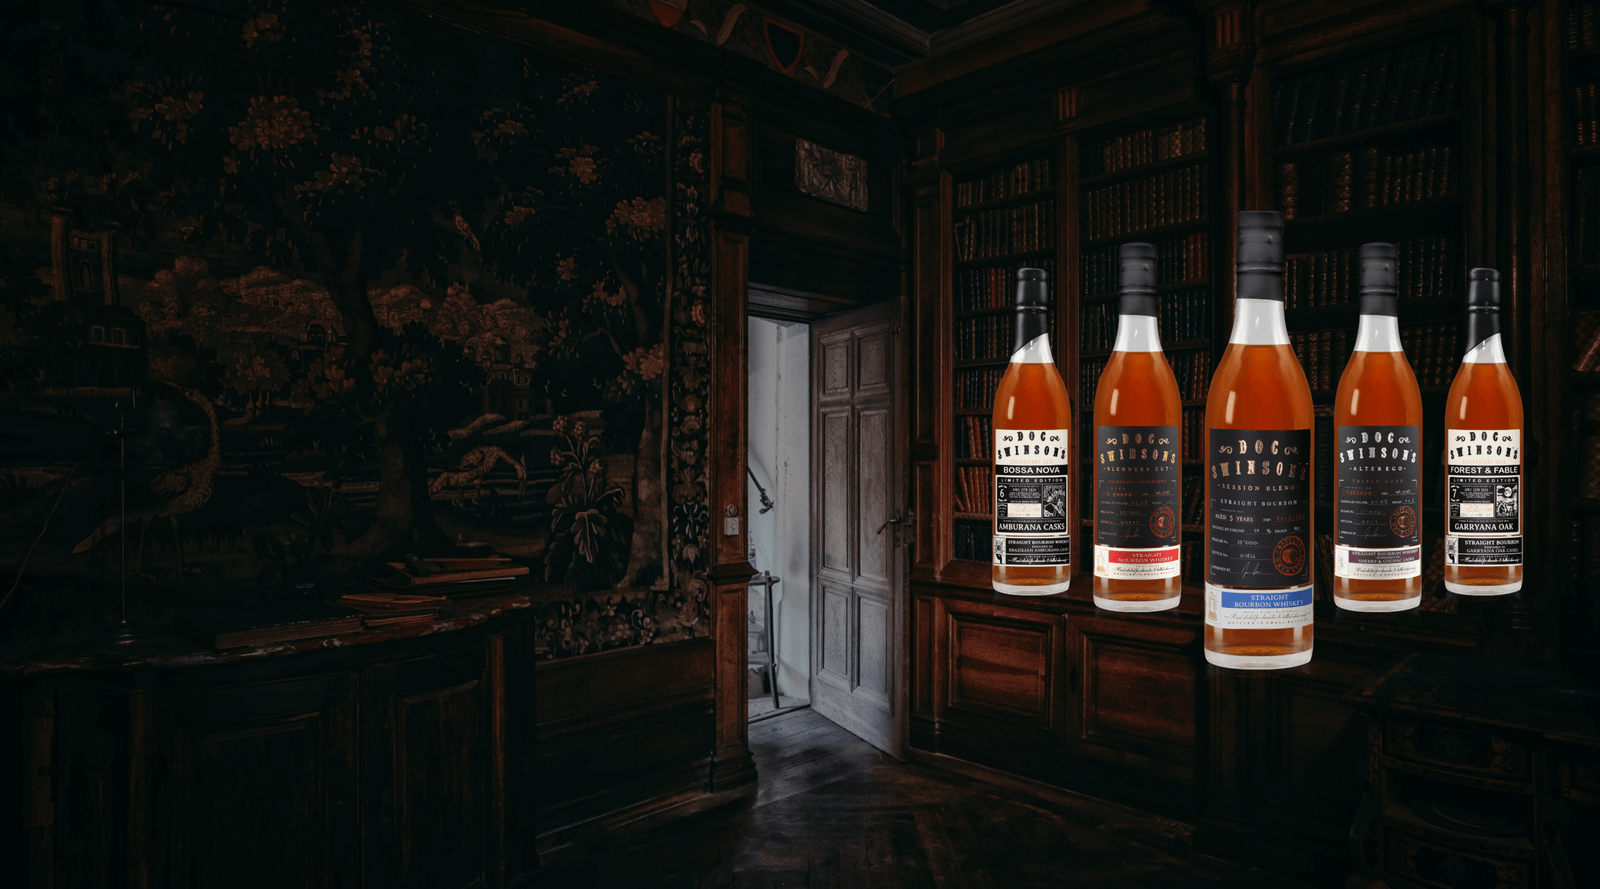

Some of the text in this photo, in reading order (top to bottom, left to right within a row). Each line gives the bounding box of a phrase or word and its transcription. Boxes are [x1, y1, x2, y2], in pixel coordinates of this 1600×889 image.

[1017, 431, 1046, 442] DOC
[1122, 433, 1154, 444] DOC
[1361, 432, 1394, 443] DOC
[1469, 432, 1498, 441] DOC
[998, 445, 1066, 460] SWINSON'S
[1239, 440, 1279, 455] DOC
[1450, 445, 1518, 460] SWINSON'S
[1100, 448, 1176, 464] SWINSON'S
[1340, 447, 1416, 463] SWINSON'S
[1212, 460, 1306, 480] SWINSON'S
[1000, 488, 1004, 498] 6
[1452, 488, 1456, 498] 7
